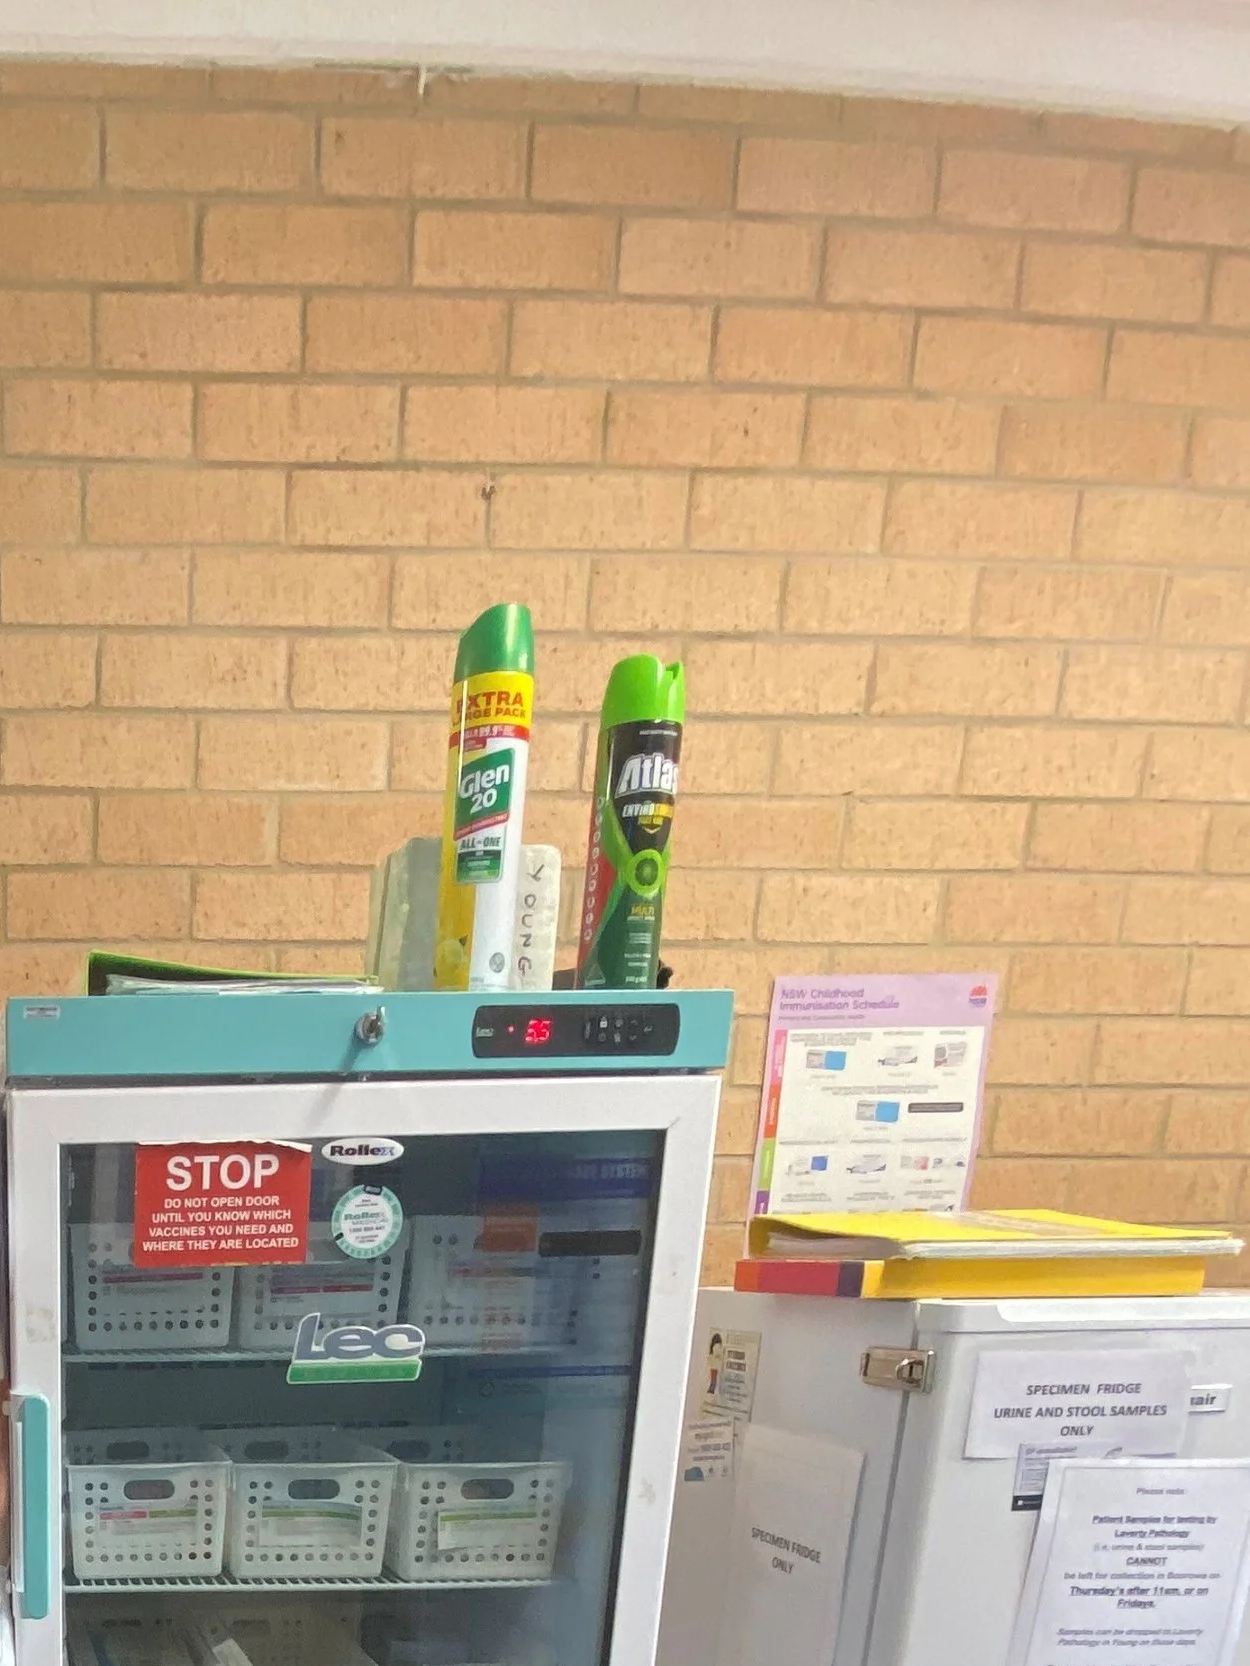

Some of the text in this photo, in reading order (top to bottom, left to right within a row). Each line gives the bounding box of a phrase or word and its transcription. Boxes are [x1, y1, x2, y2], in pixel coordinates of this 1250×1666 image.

[494, 707, 526, 718] PACK
[459, 764, 510, 799] Glen
[469, 788, 498, 814] 20
[810, 988, 865, 999] Childhood
[779, 1000, 900, 1011] Immunisation Schedule
[166, 1154, 280, 1191] STOP
[164, 1196, 280, 1209] DO NOT OPEN DOOR
[152, 1210, 291, 1223] UNTIL YOU KNOW WHICH
[149, 1223, 293, 1238] VACCINES YOU NEED AND
[142, 1238, 299, 1251] WHERE THEY ARE LOCATED
[293, 1313, 426, 1360] Lec
[1026, 1383, 1142, 1396] SPECIMEN FRIDGE
[994, 1405, 1168, 1418] URINE AND STOOL SAMPLES
[1060, 1425, 1094, 1436] ONLY
[1092, 1515, 1123, 1524] Patient
[1163, 1515, 1175, 1524] for
[1149, 1530, 1190, 1539] Pathology
[751, 1527, 821, 1564] SPECIMEN FRIDGE
[771, 1556, 794, 1574] ONLY
[1126, 1557, 1168, 1566] CANNOT
[1078, 1572, 1093, 1580] left
[1070, 1586, 1124, 1597] Thursday's
[1127, 1586, 1150, 1596] after
[1184, 1587, 1194, 1596] or
[1196, 1587, 1209, 1596] on
